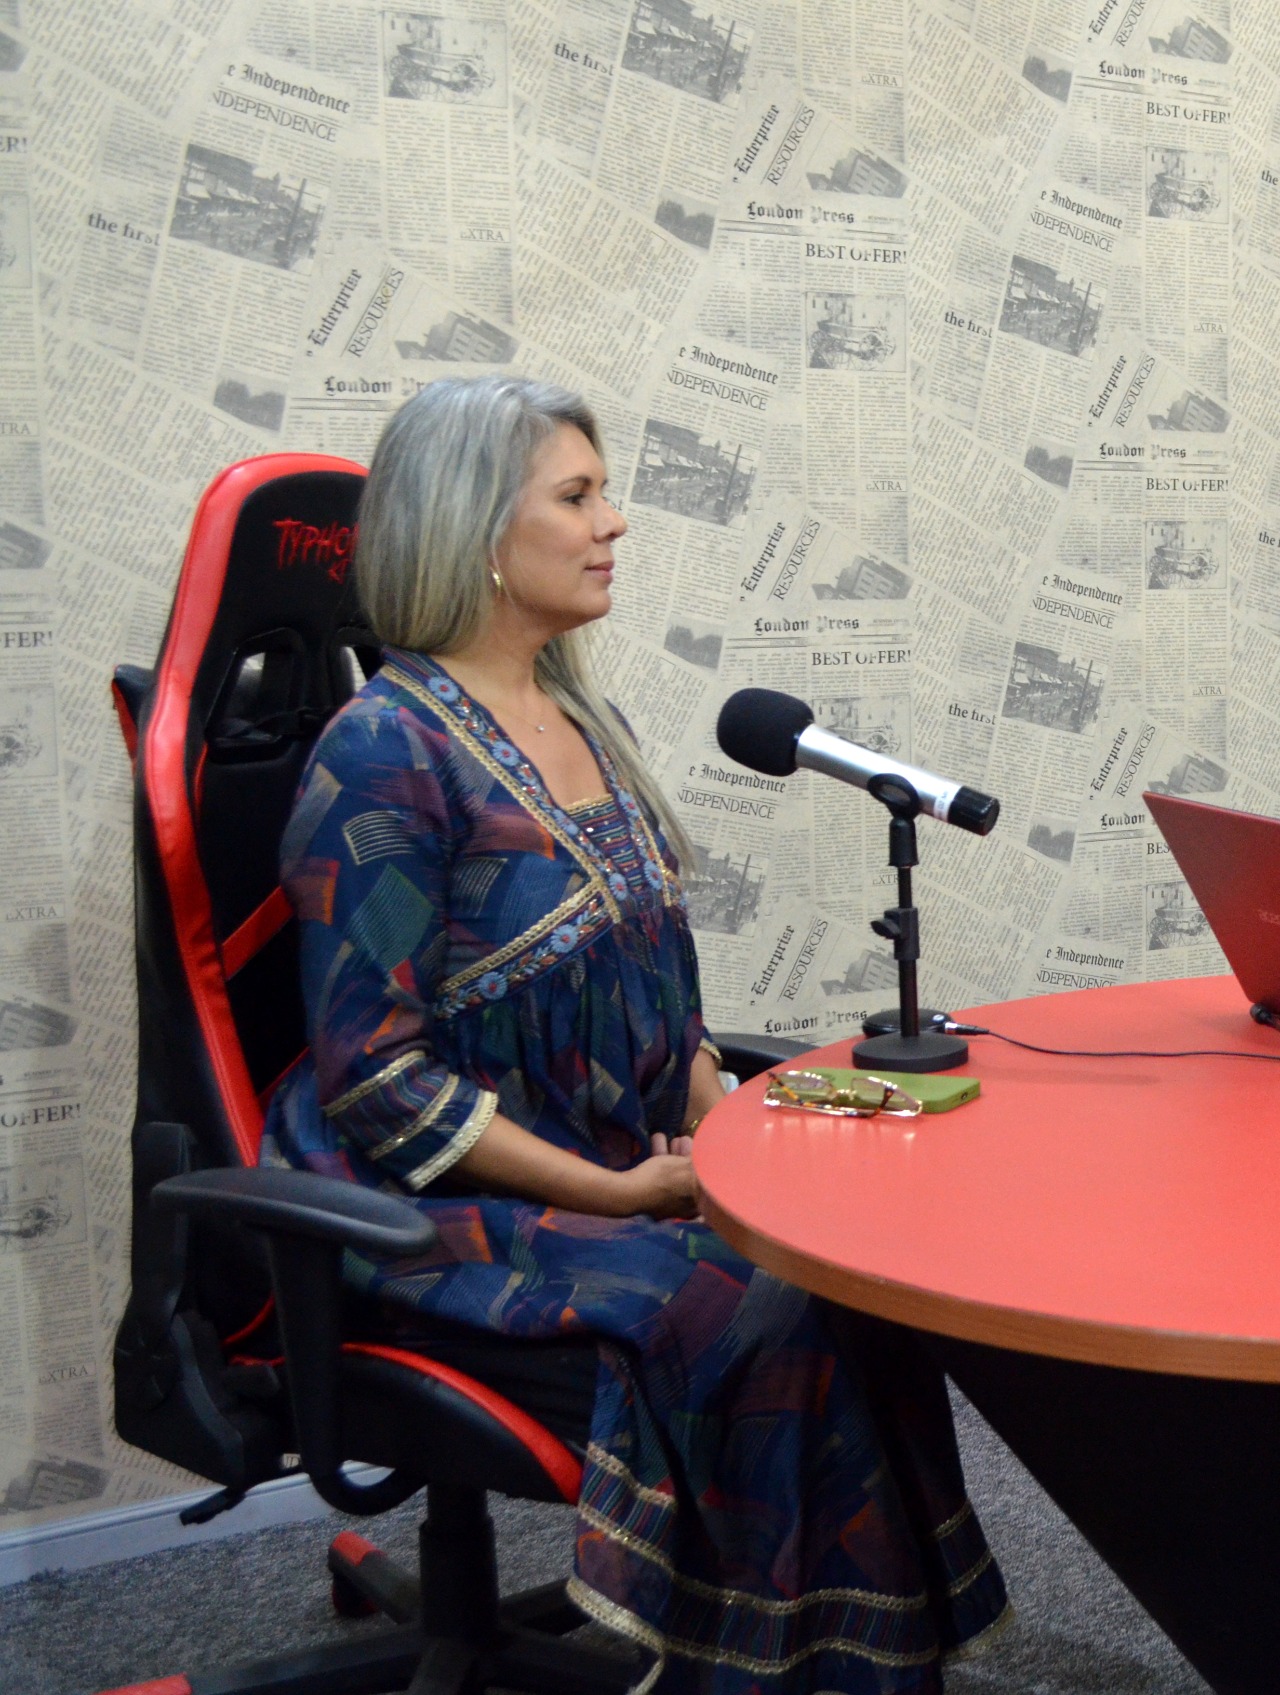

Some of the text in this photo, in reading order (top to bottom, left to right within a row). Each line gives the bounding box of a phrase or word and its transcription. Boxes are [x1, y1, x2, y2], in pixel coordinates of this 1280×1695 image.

[554, 42, 579, 64] the
[1098, 60, 1145, 80] London
[242, 65, 350, 114] Independence
[1146, 102, 1179, 119] BEST
[767, 106, 814, 186] RESOURCES
[1261, 169, 1279, 187] the
[747, 201, 802, 221] London
[1048, 190, 1123, 229] Independence
[87, 212, 119, 237] the
[805, 243, 845, 260] BEST
[348, 268, 404, 358] RESOURCES
[944, 311, 963, 327] the
[690, 345, 778, 385] Independence
[1115, 354, 1155, 428] RESOURCES
[1099, 442, 1145, 460] London
[1146, 477, 1179, 492] BEST
[1258, 531, 1277, 546] the
[773, 519, 820, 601] RESOURCES
[1052, 574, 1123, 606] Independence
[753, 617, 809, 636] London
[811, 651, 851, 666] BEST
[948, 703, 968, 720] the
[1117, 724, 1156, 797] RESOURCES
[700, 763, 786, 794] Independence
[1101, 811, 1145, 829] London
[1147, 842, 1171, 856] BES
[752, 925, 795, 996] Enterprise
[784, 919, 828, 1000] RESOURCES
[1056, 946, 1124, 970] Independence
[764, 1015, 818, 1035] London
